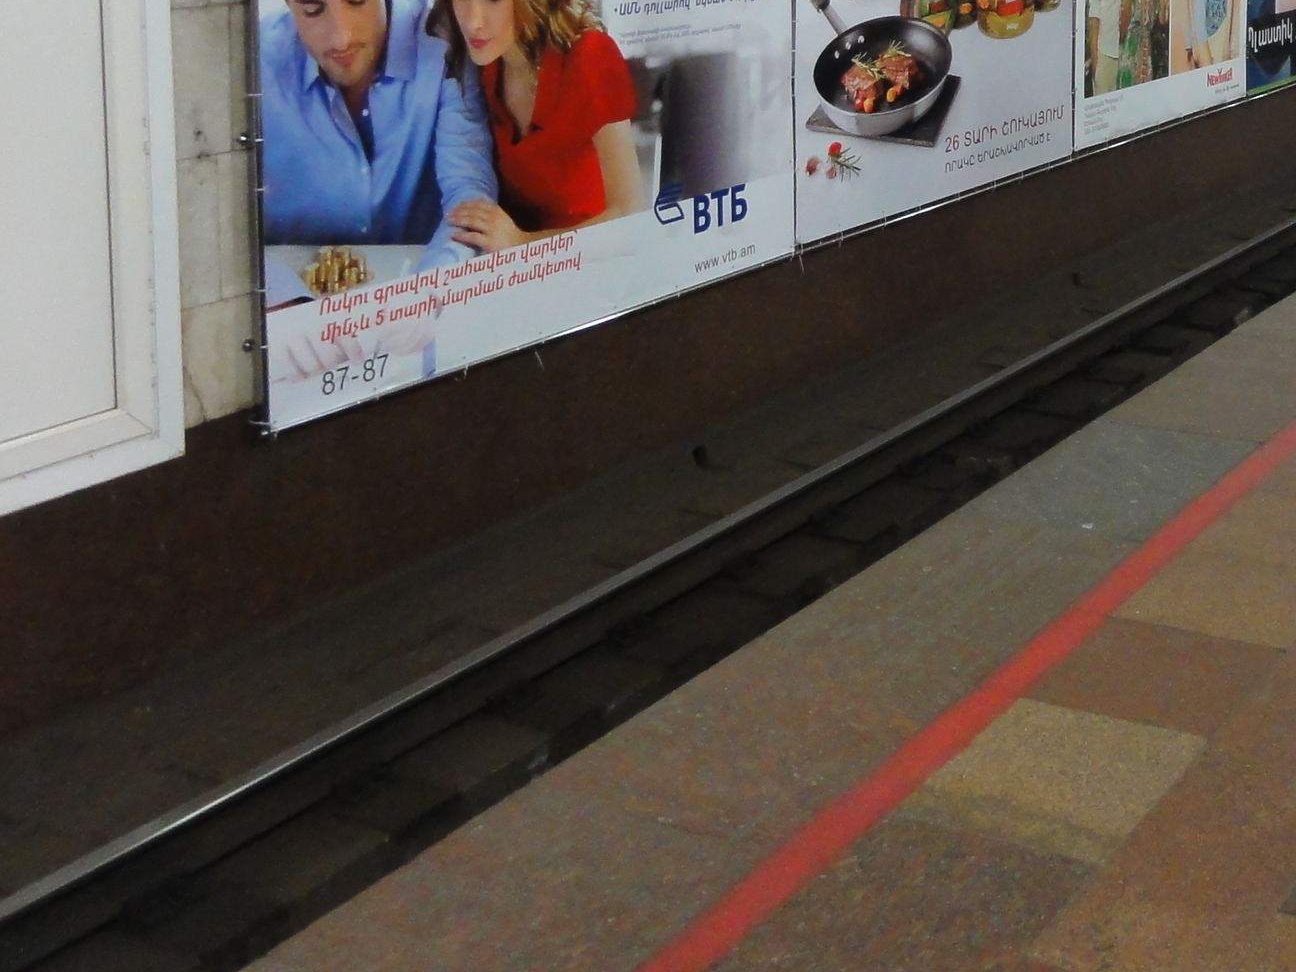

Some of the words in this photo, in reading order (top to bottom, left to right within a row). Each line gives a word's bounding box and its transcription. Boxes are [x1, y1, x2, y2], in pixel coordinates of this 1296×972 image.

[619, 1, 641, 15] ԱՄՆ
[1248, 18, 1293, 53] Պլաստիկ
[945, 135, 959, 153] 26
[964, 125, 997, 147] ՏԱՐԻ
[1001, 105, 1064, 136] ՇՈՒԿԱՅՈՒՄ
[945, 155, 975, 173] ՈՐԱԿԸ
[693, 183, 748, 235] ВТБ
[694, 244, 756, 273] www.vtb.am
[320, 292, 368, 316] Ոսկու
[374, 268, 440, 305] գրավով
[443, 249, 516, 288] շահավետ
[375, 309, 385, 327] 5
[389, 294, 437, 322] տարի
[442, 276, 503, 307] մարման
[508, 251, 582, 288] ժամկետով
[322, 353, 390, 396] 87-87
